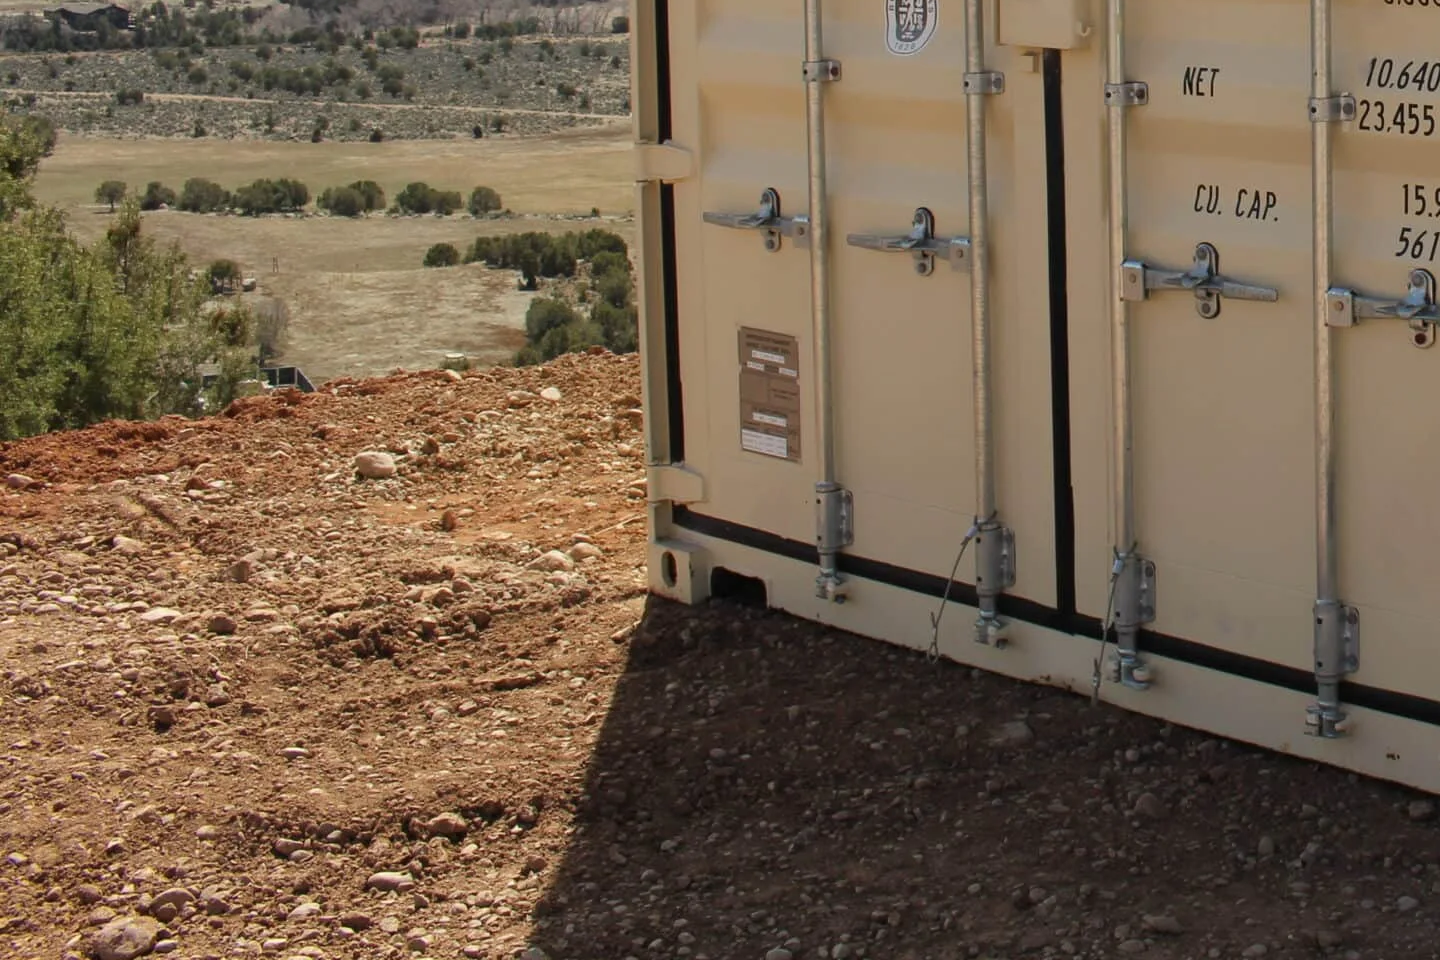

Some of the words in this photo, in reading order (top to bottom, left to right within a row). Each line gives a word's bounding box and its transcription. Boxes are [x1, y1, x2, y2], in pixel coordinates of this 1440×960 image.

[1183, 67, 1221, 97] NET
[1359, 100, 1435, 137] 23,455
[1194, 184, 1222, 216] CU.
[1235, 189, 1279, 222] CAP.
[1396, 227, 1440, 262] 561
